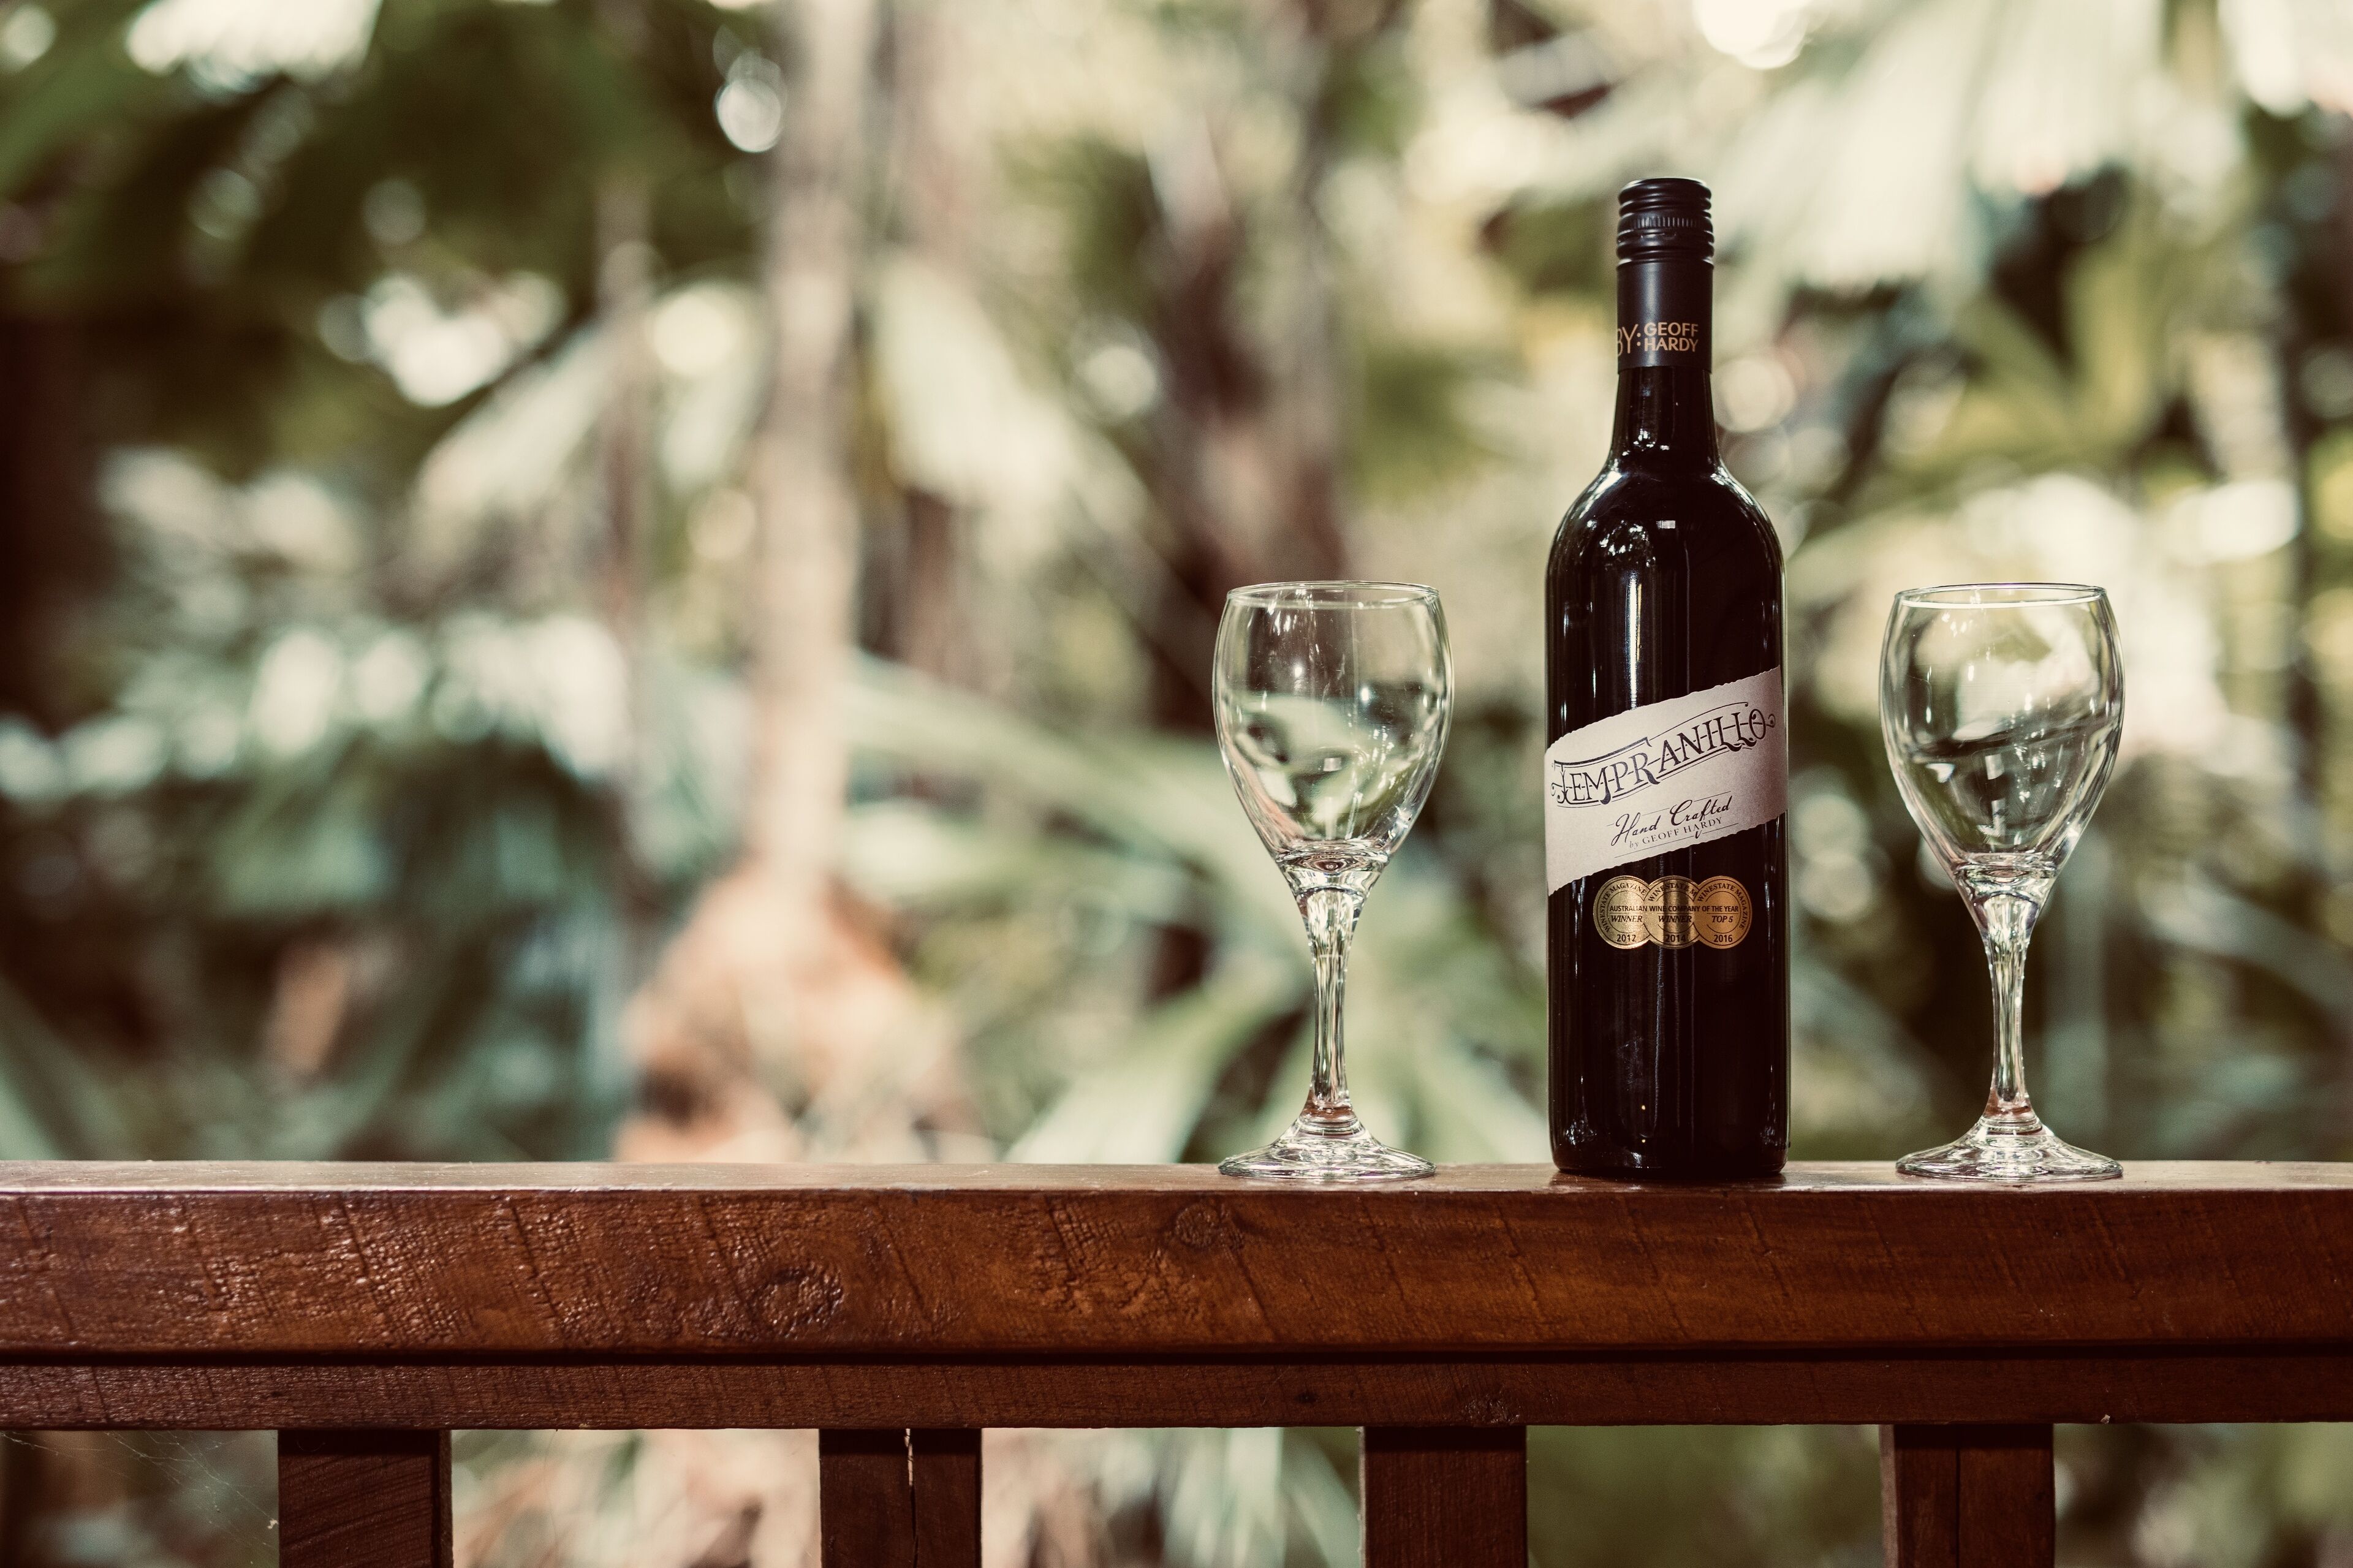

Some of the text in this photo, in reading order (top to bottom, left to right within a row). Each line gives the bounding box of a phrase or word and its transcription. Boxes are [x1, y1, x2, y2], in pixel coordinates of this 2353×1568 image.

[1643, 322, 1699, 338] GEOFF
[1643, 337, 1699, 352] HARDY
[1551, 702, 1776, 808] TEMPRANILLO
[1610, 796, 1733, 846] Hand Crafted
[1629, 817, 1723, 849] by GEOFF HARDY
[1648, 882, 1689, 902] WINESTATE
[1599, 882, 1647, 933] WINESTATE MAGAZINE
[1697, 883, 1748, 930] WINESTATE MAGAZINE
[1616, 934, 1636, 942] 2012
[1665, 934, 1686, 942] 2014
[1713, 934, 1733, 942] 2016
